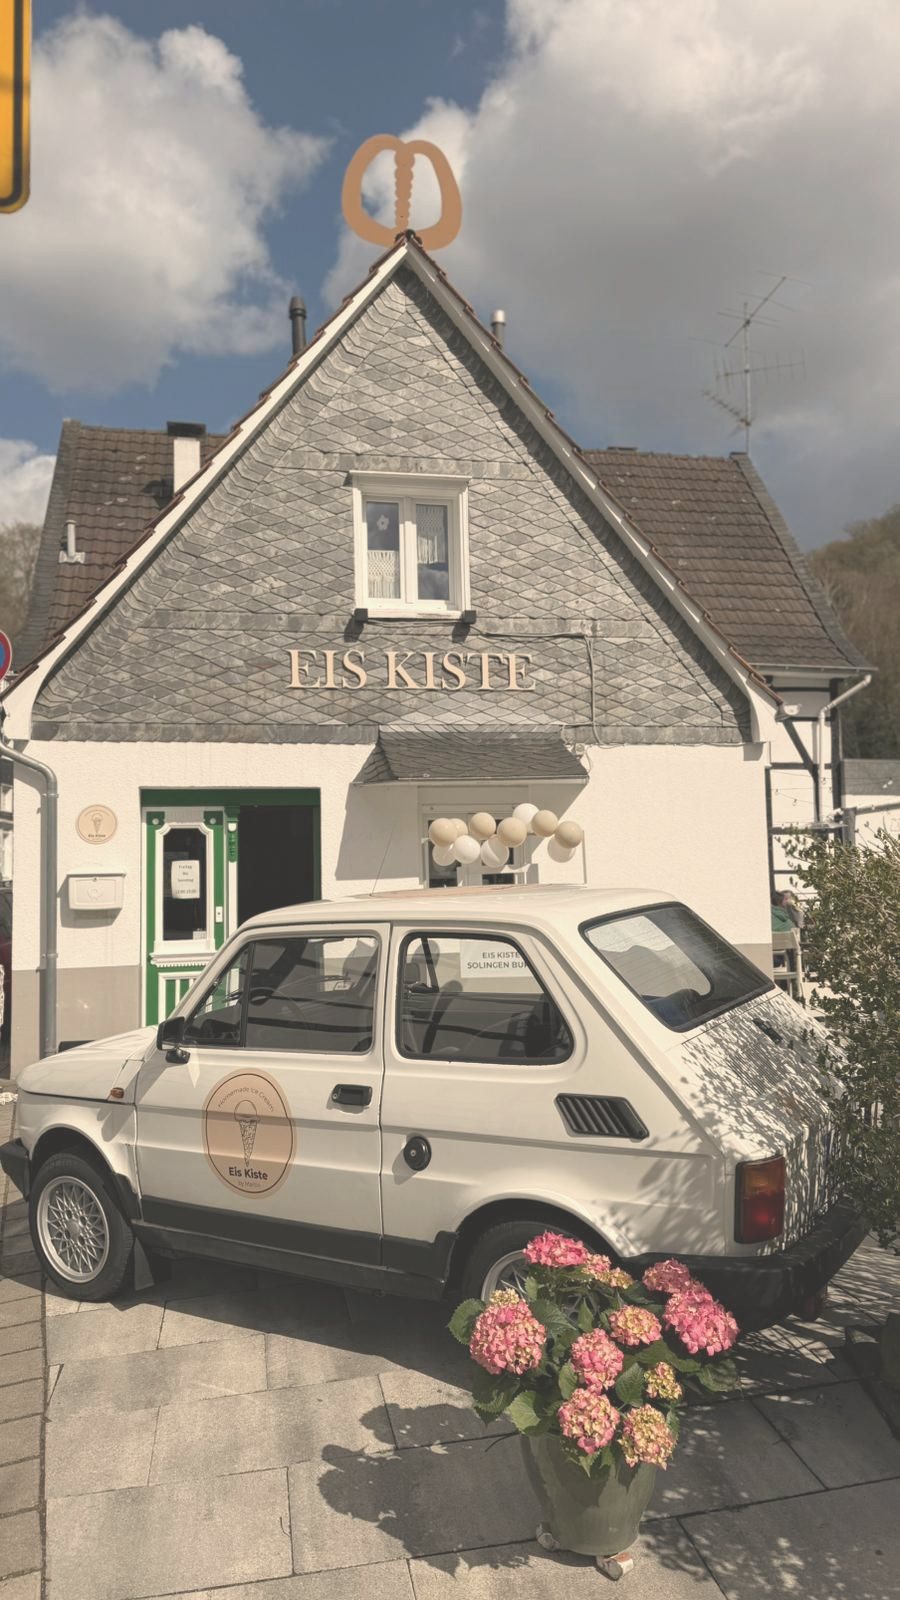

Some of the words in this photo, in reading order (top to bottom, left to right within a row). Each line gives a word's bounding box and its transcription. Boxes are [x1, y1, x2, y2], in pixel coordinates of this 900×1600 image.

[287, 649, 368, 690] EIS
[384, 650, 536, 691] KISTE
[482, 951, 496, 959] EIS
[497, 951, 521, 959] KISTE
[467, 961, 510, 969] SOLINGEN
[217, 1087, 250, 1109] Homemade
[228, 1166, 243, 1178] Eis
[244, 1167, 269, 1181] Kiste
